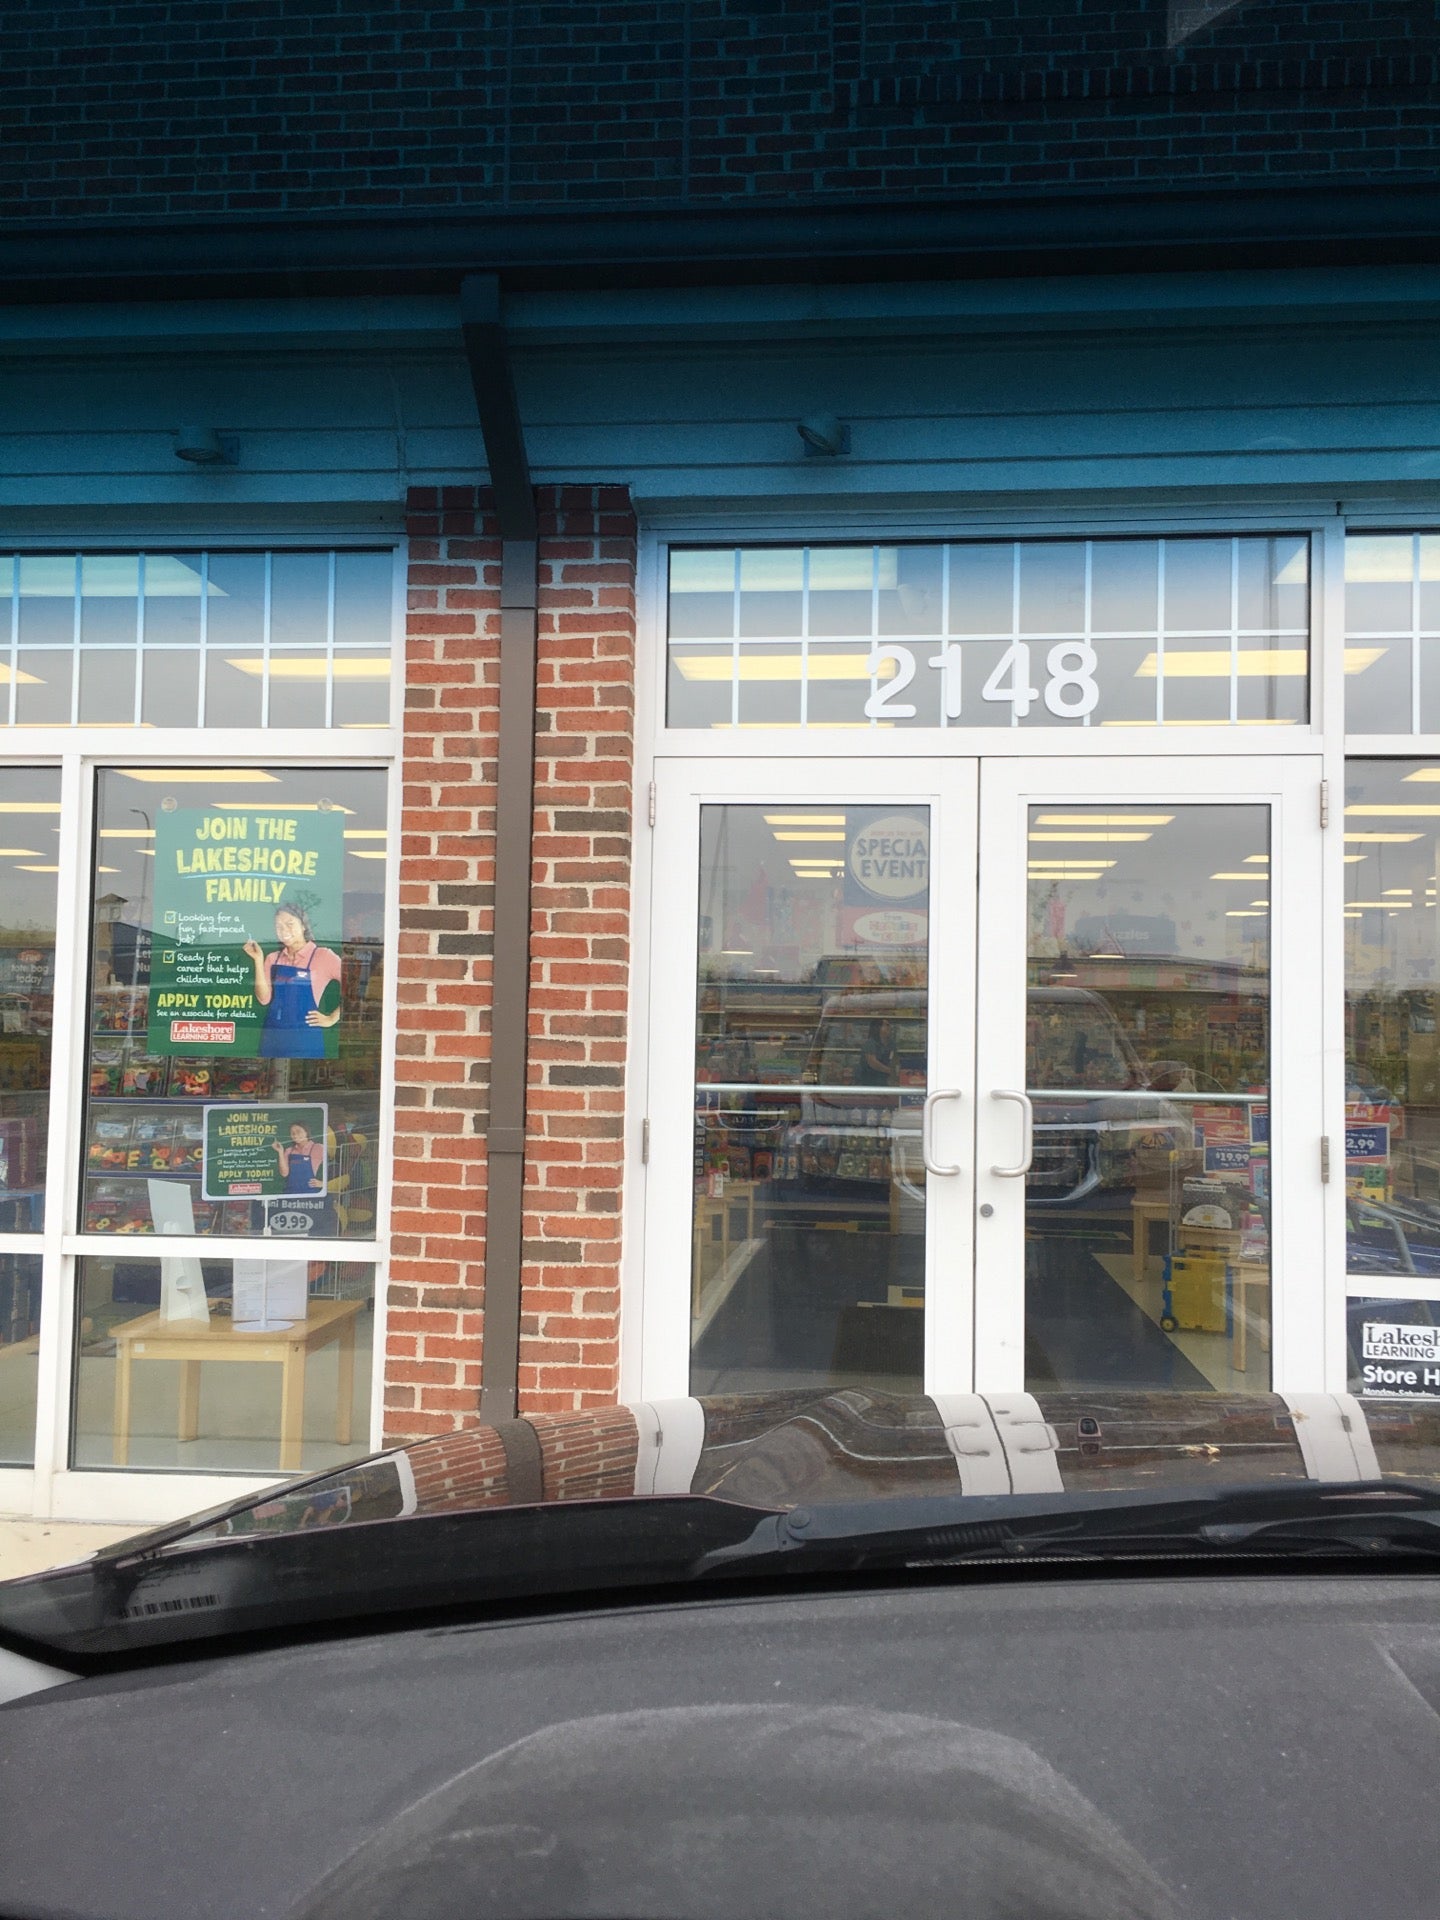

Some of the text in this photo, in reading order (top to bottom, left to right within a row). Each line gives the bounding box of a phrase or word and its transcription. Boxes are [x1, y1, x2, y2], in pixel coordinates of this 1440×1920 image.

[864, 642, 1099, 718] 2148
[196, 817, 298, 841] JOIN THE
[857, 838, 927, 856] SPECIA
[176, 846, 319, 876] LAKESHORE
[861, 859, 927, 877] EVENT
[205, 878, 286, 903] FAMILY
[178, 912, 214, 924] Looking
[217, 911, 231, 924] for
[178, 922, 245, 937] fun, fast-paced
[176, 934, 195, 946] job?
[177, 953, 204, 966] Ready
[207, 952, 222, 965] for
[207, 965, 224, 973] that
[226, 965, 249, 977] helps
[176, 975, 243, 984] children learn?
[157, 993, 253, 1008] APPLY TODAY!
[216, 1010, 228, 1019] for
[174, 1022, 233, 1034] Lakeshore
[226, 1113, 269, 1122] JOIN THE
[218, 1125, 278, 1135] LAKESHORE
[231, 1136, 265, 1146] FAMILY
[218, 1169, 273, 1178] APPLY TODAY!
[282, 1200, 324, 1209] Basketball
[274, 1214, 308, 1229] $9.99
[1366, 1345, 1435, 1358] LEARNING
[1363, 1365, 1440, 1386] Store H
